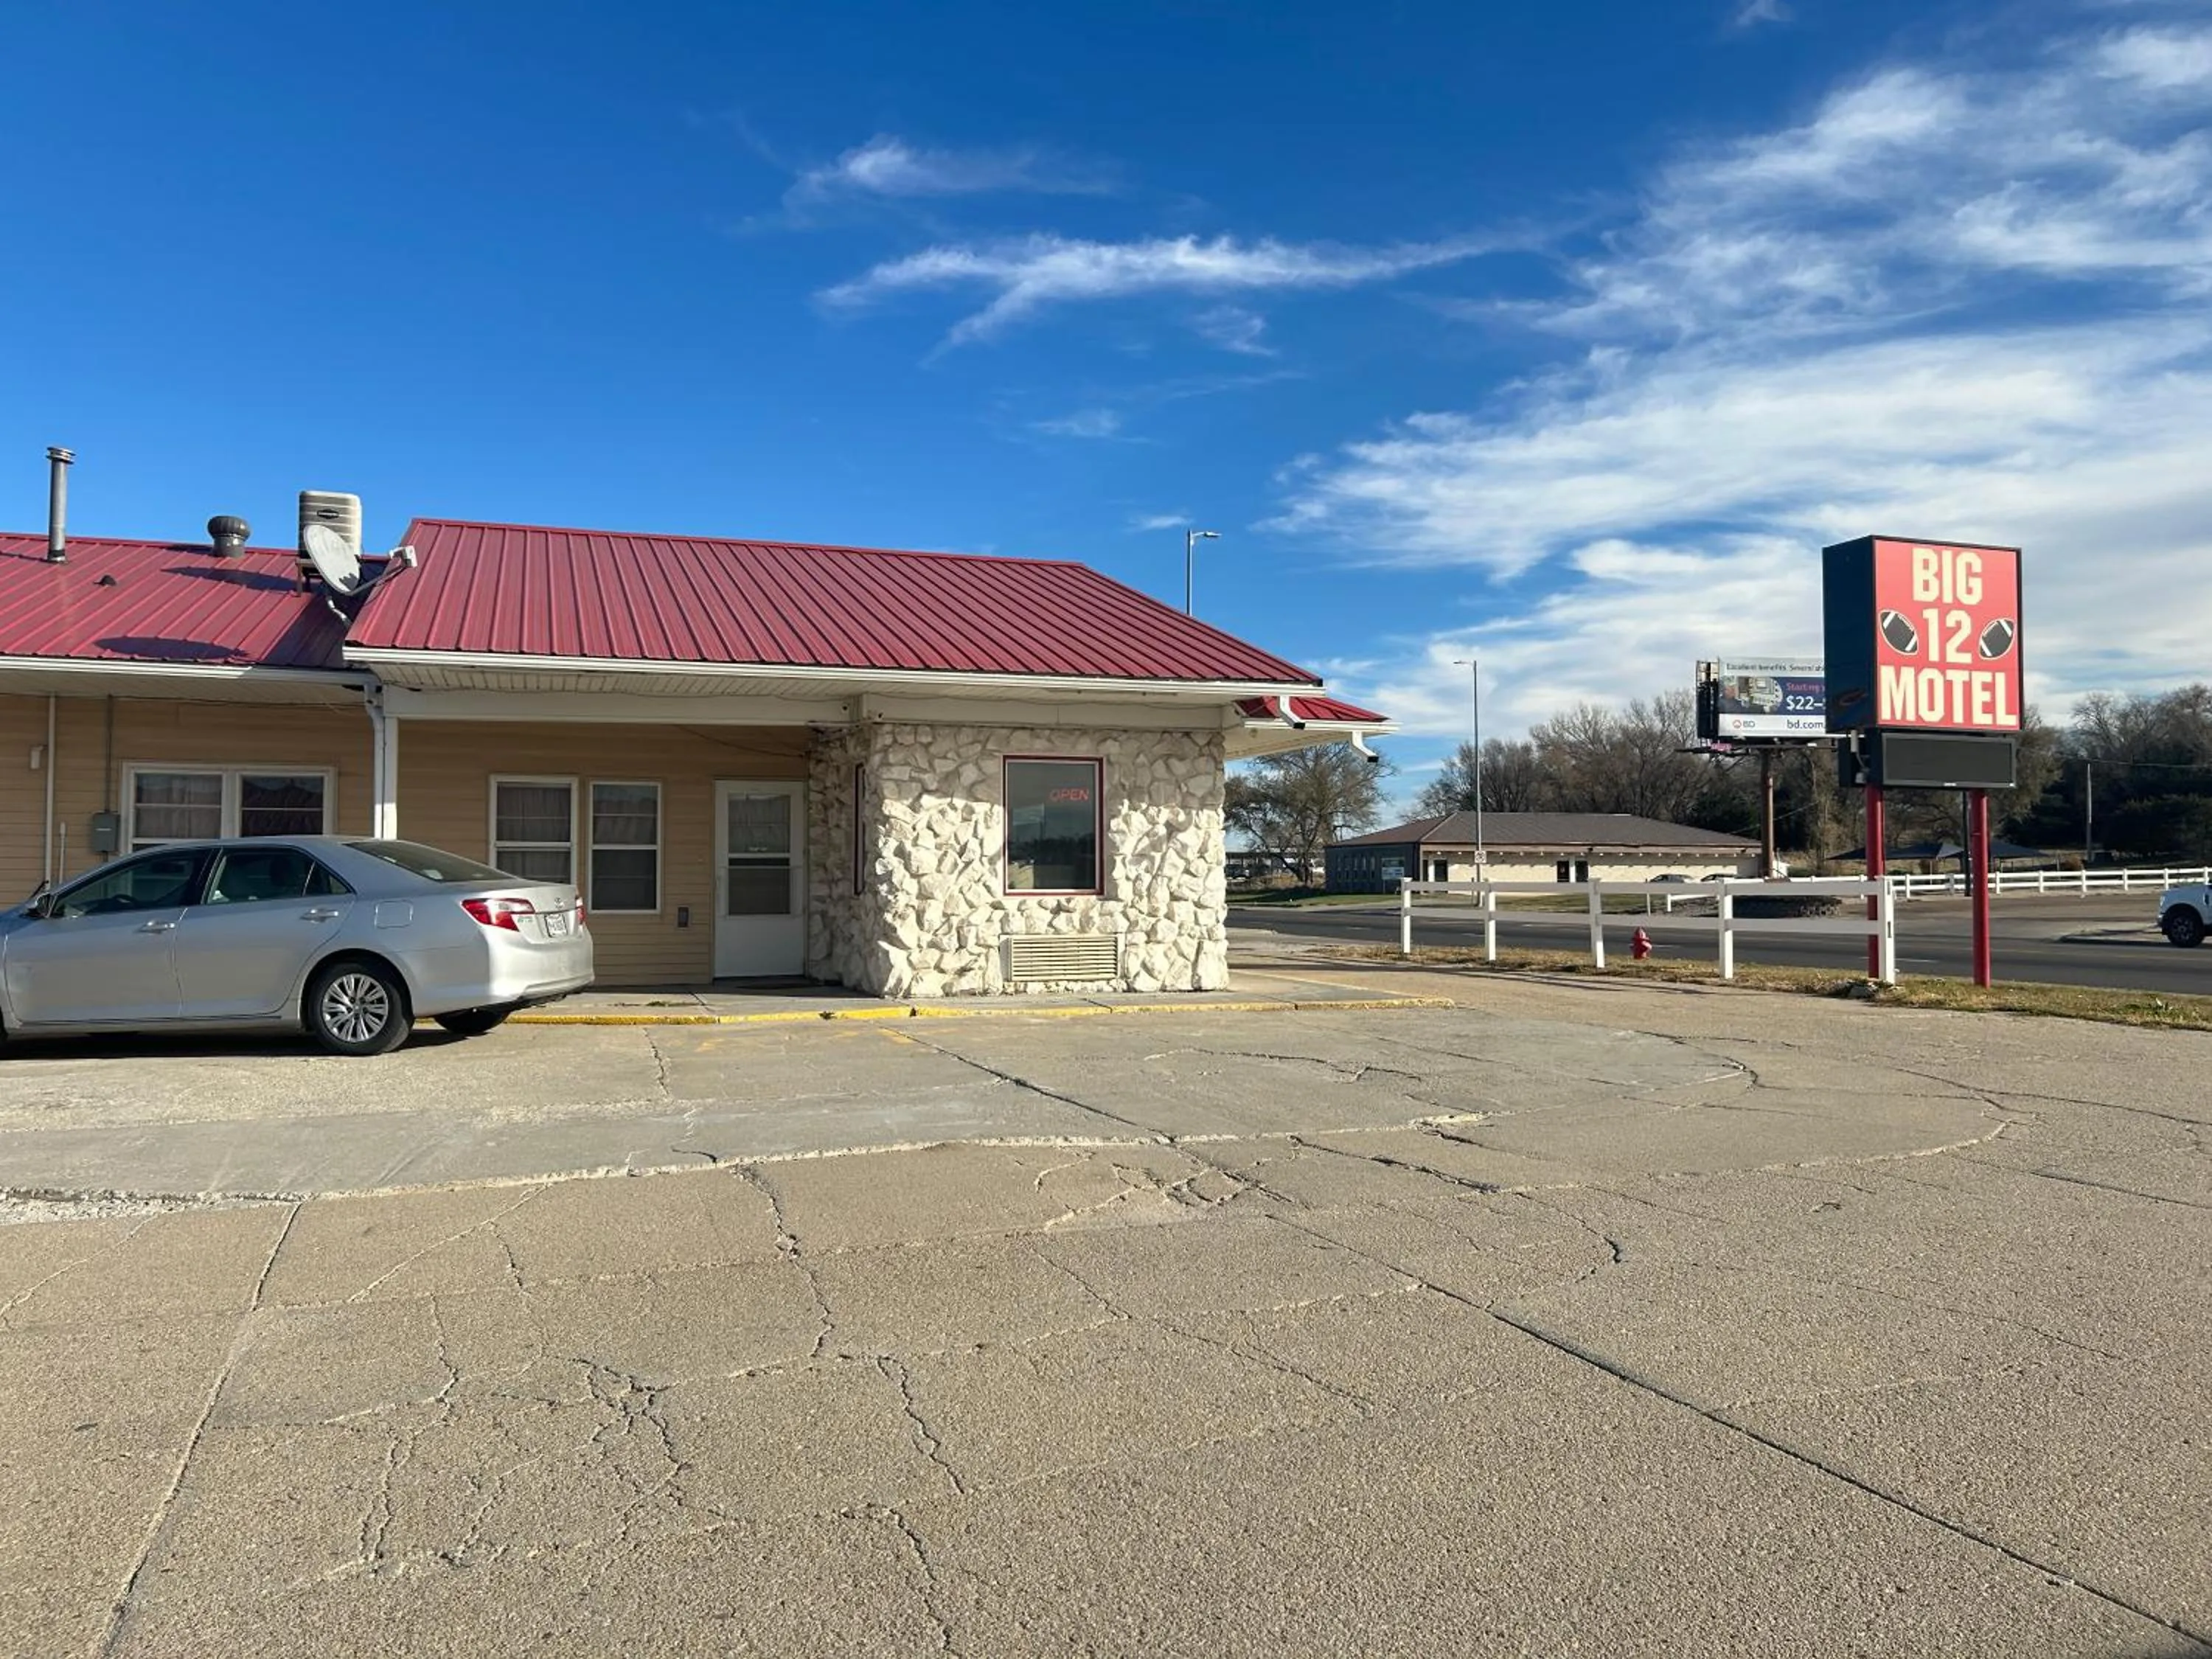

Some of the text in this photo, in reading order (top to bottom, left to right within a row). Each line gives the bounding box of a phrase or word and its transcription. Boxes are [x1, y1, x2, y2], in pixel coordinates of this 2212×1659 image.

[1913, 548, 1983, 605] BIG
[1922, 608, 1972, 664] 12
[1787, 695, 1825, 711] $22-
[1881, 665, 2017, 726] MOTEL
[1049, 789, 1089, 801] OPEN
